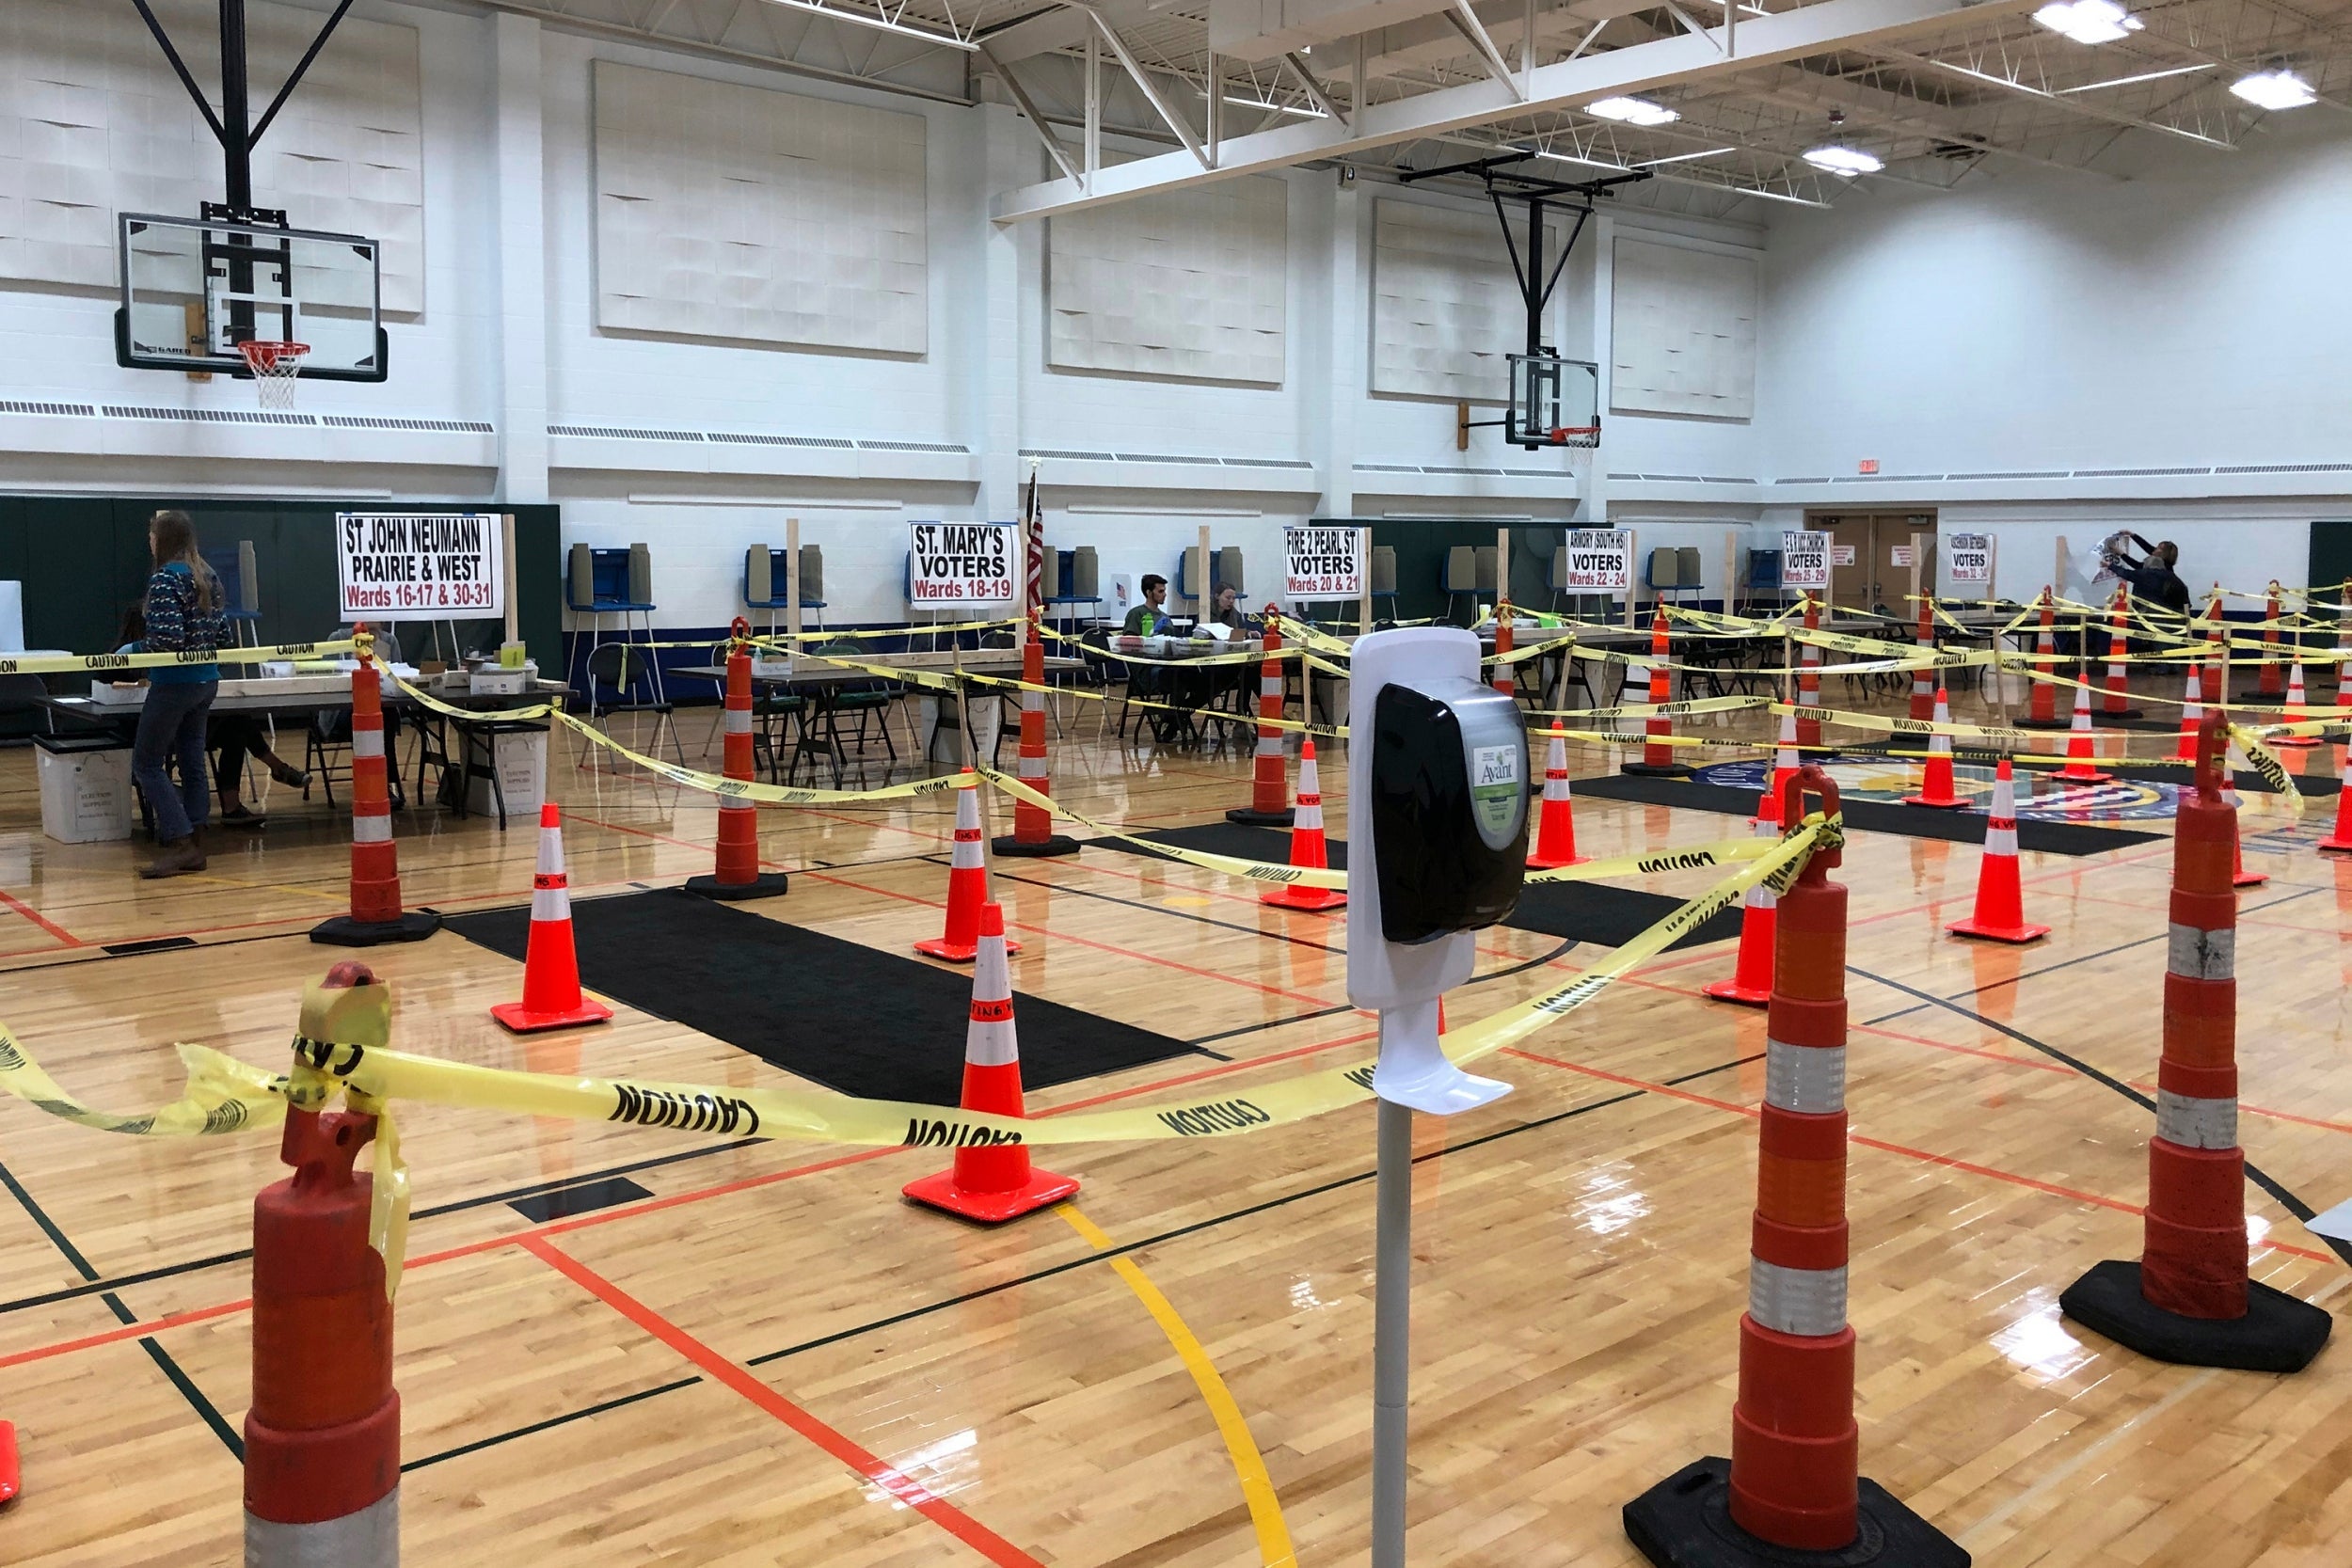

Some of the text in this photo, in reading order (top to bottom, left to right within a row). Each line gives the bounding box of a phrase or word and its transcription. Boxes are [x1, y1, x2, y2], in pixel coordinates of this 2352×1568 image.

[346, 518, 481, 553] ST JOHN NEUMANN
[915, 525, 1003, 555] ST. MARY'S
[1287, 531, 1356, 555] FIRE 2 PEARL ST
[1570, 531, 1593, 548] ARMORY
[353, 555, 481, 582] PRAIRIE & WEST
[920, 556, 1005, 578] VOTERS
[1291, 556, 1354, 575] VOTERS
[1572, 554, 1622, 571] VOTERS
[1788, 553, 1822, 568] VOTERS
[1953, 553, 1985, 567] VOTERS
[1569, 571, 1595, 585] Wards
[1597, 571, 1607, 585] 22
[1614, 572, 1625, 585] 24
[1785, 569, 1802, 581] Wards
[1804, 569, 1811, 581] 25
[1815, 569, 1824, 581] 29
[1952, 568, 1969, 578] Wards
[914, 578, 1010, 598] Wards 18-19
[1288, 575, 1358, 593] Wards 20 & 21
[346, 583, 490, 608] Wards 16-17 & 30-31
[176, 649, 217, 663] CAUTION
[277, 643, 315, 656] CAUTION
[85, 654, 130, 669] CAUTION
[1932, 653, 1967, 666] CAUTION
[1657, 702, 1691, 716] CAUTION
[1304, 722, 1337, 735] CAUTION
[1481, 762, 1513, 784] Avant
[913, 779, 950, 795] CAUTION
[1638, 850, 1716, 874] CAUTION
[607, 1084, 760, 1136] CAUTION
[901, 1117, 1024, 1148] CAUTION
